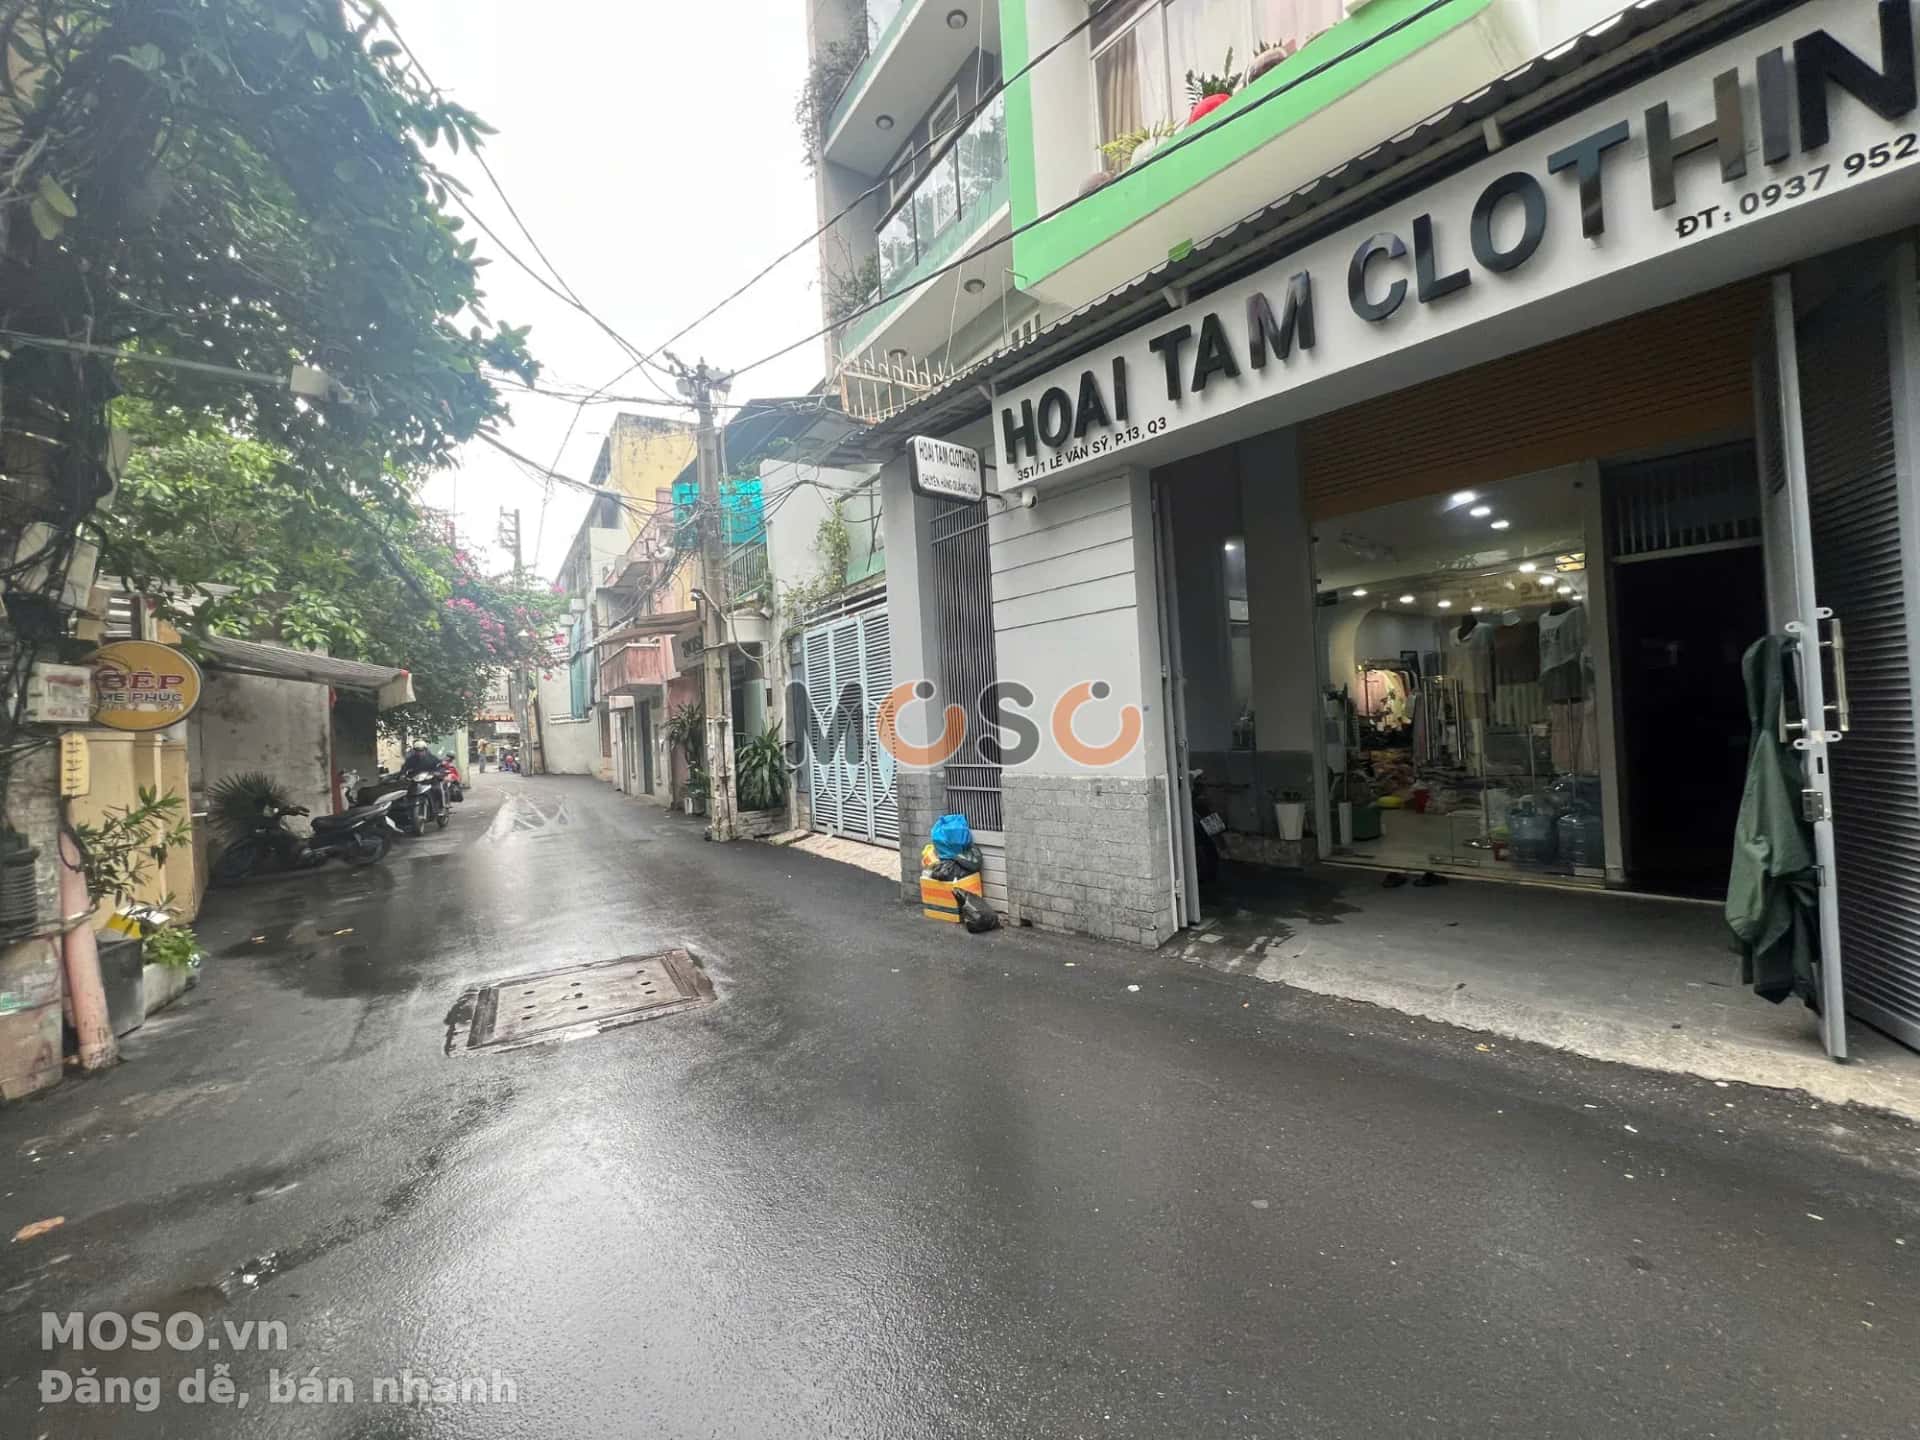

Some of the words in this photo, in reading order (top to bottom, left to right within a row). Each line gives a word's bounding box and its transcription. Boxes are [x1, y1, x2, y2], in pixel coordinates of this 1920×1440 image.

[1675, 204, 1731, 239] ĐT:
[1738, 163, 1831, 216] 0937
[1843, 132, 1919, 178] 952
[1001, 355, 1129, 465] HOAI
[1148, 269, 1316, 401] TAM
[1346, 0, 1918, 323] CLOTHIN
[949, 447, 977, 472] CLOTHING
[1017, 461, 1046, 481] 351/1
[1049, 452, 1063, 470] LÊ
[1065, 444, 1089, 463] VĂN
[1147, 416, 1167, 434] Q3
